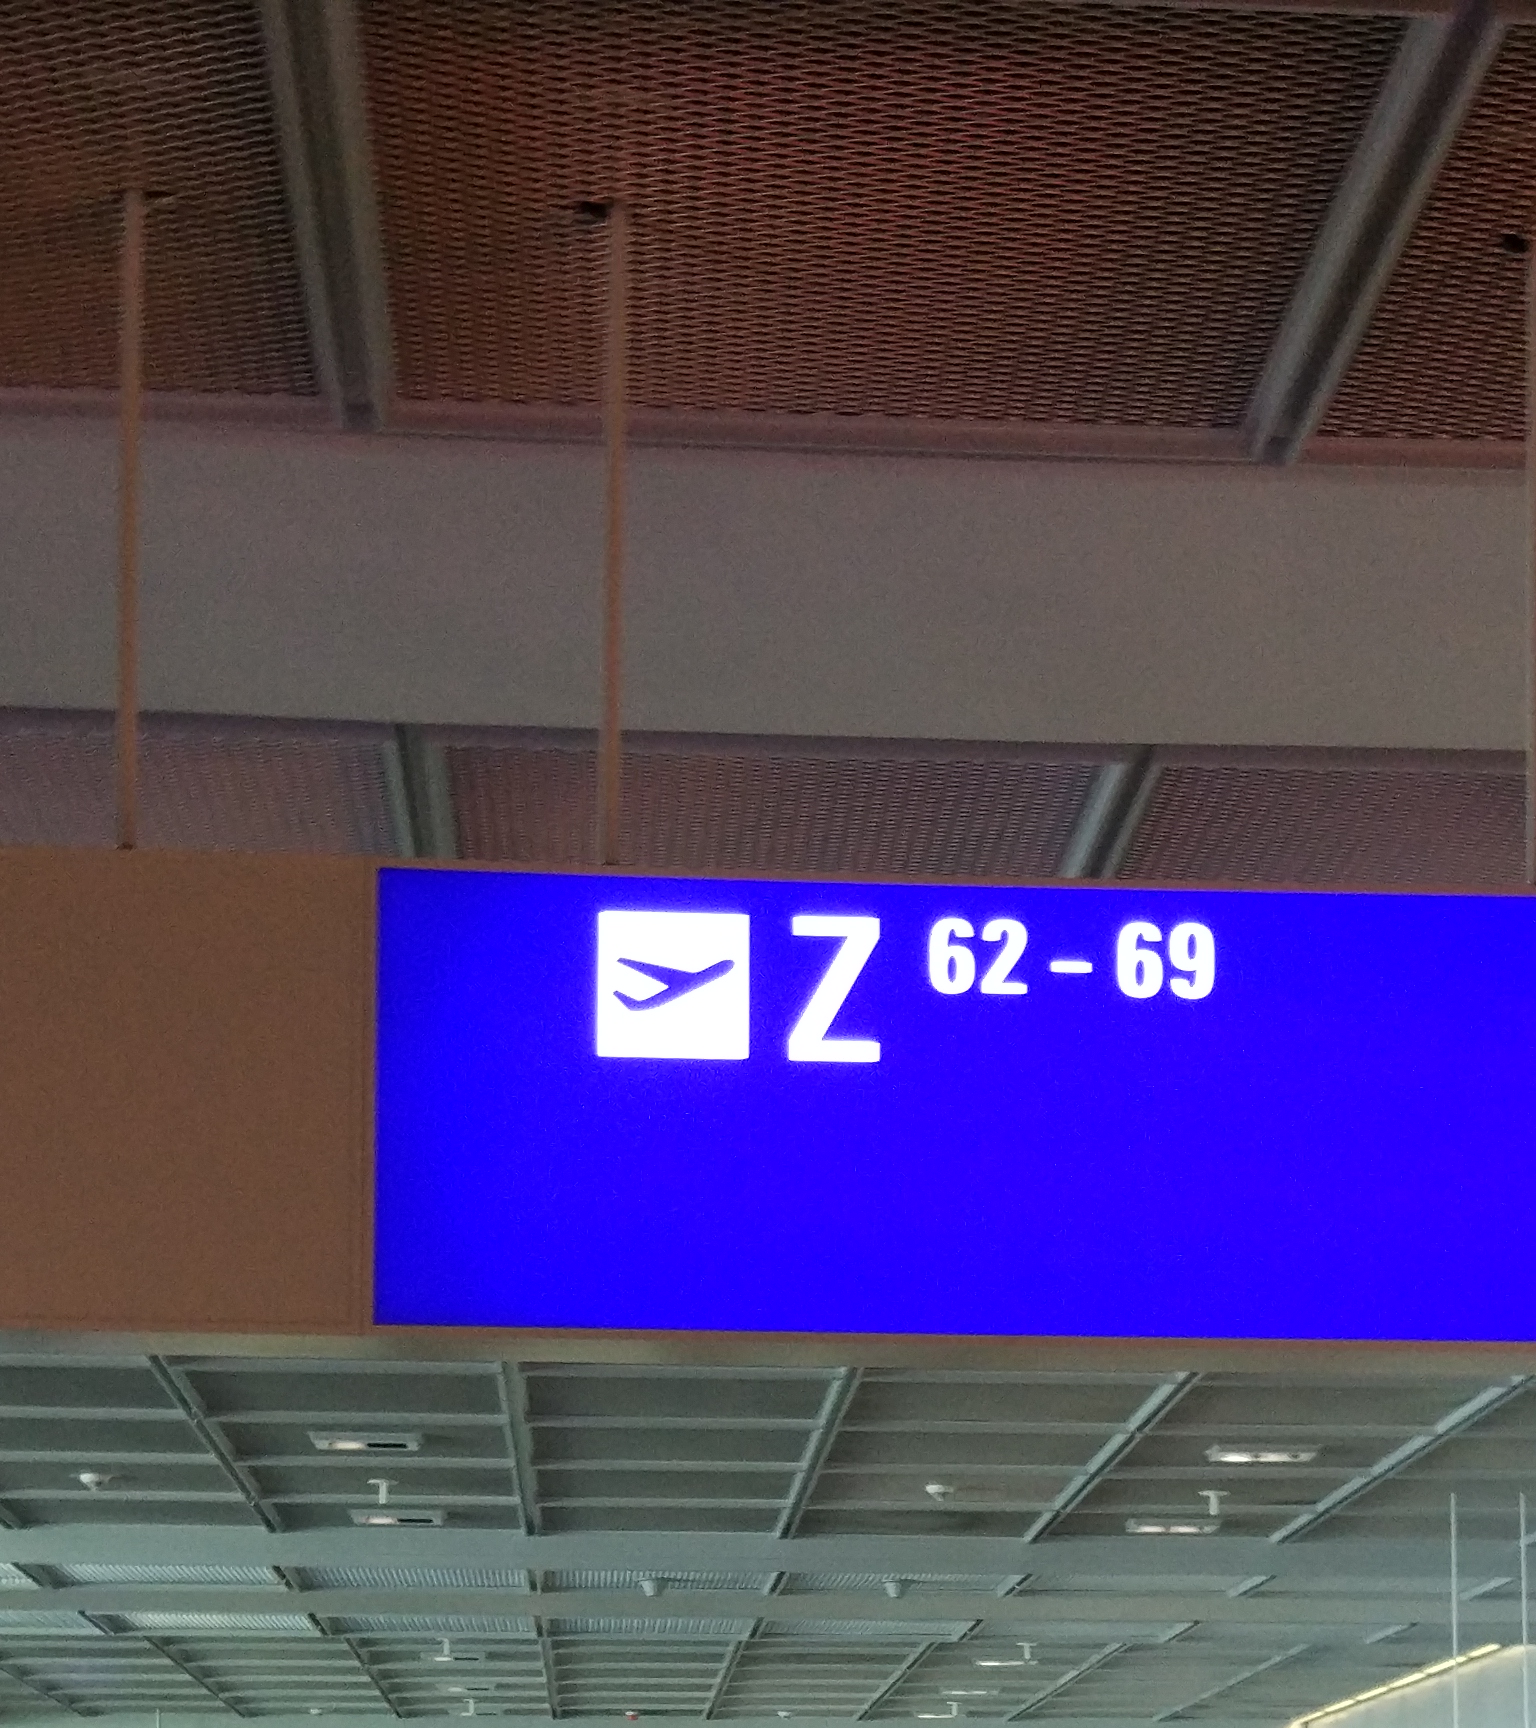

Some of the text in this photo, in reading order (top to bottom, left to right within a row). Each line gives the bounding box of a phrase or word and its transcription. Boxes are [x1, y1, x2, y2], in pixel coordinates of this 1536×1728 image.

[787, 915, 881, 1063] Z
[928, 916, 1029, 996] 62
[1115, 921, 1216, 1000] 69
